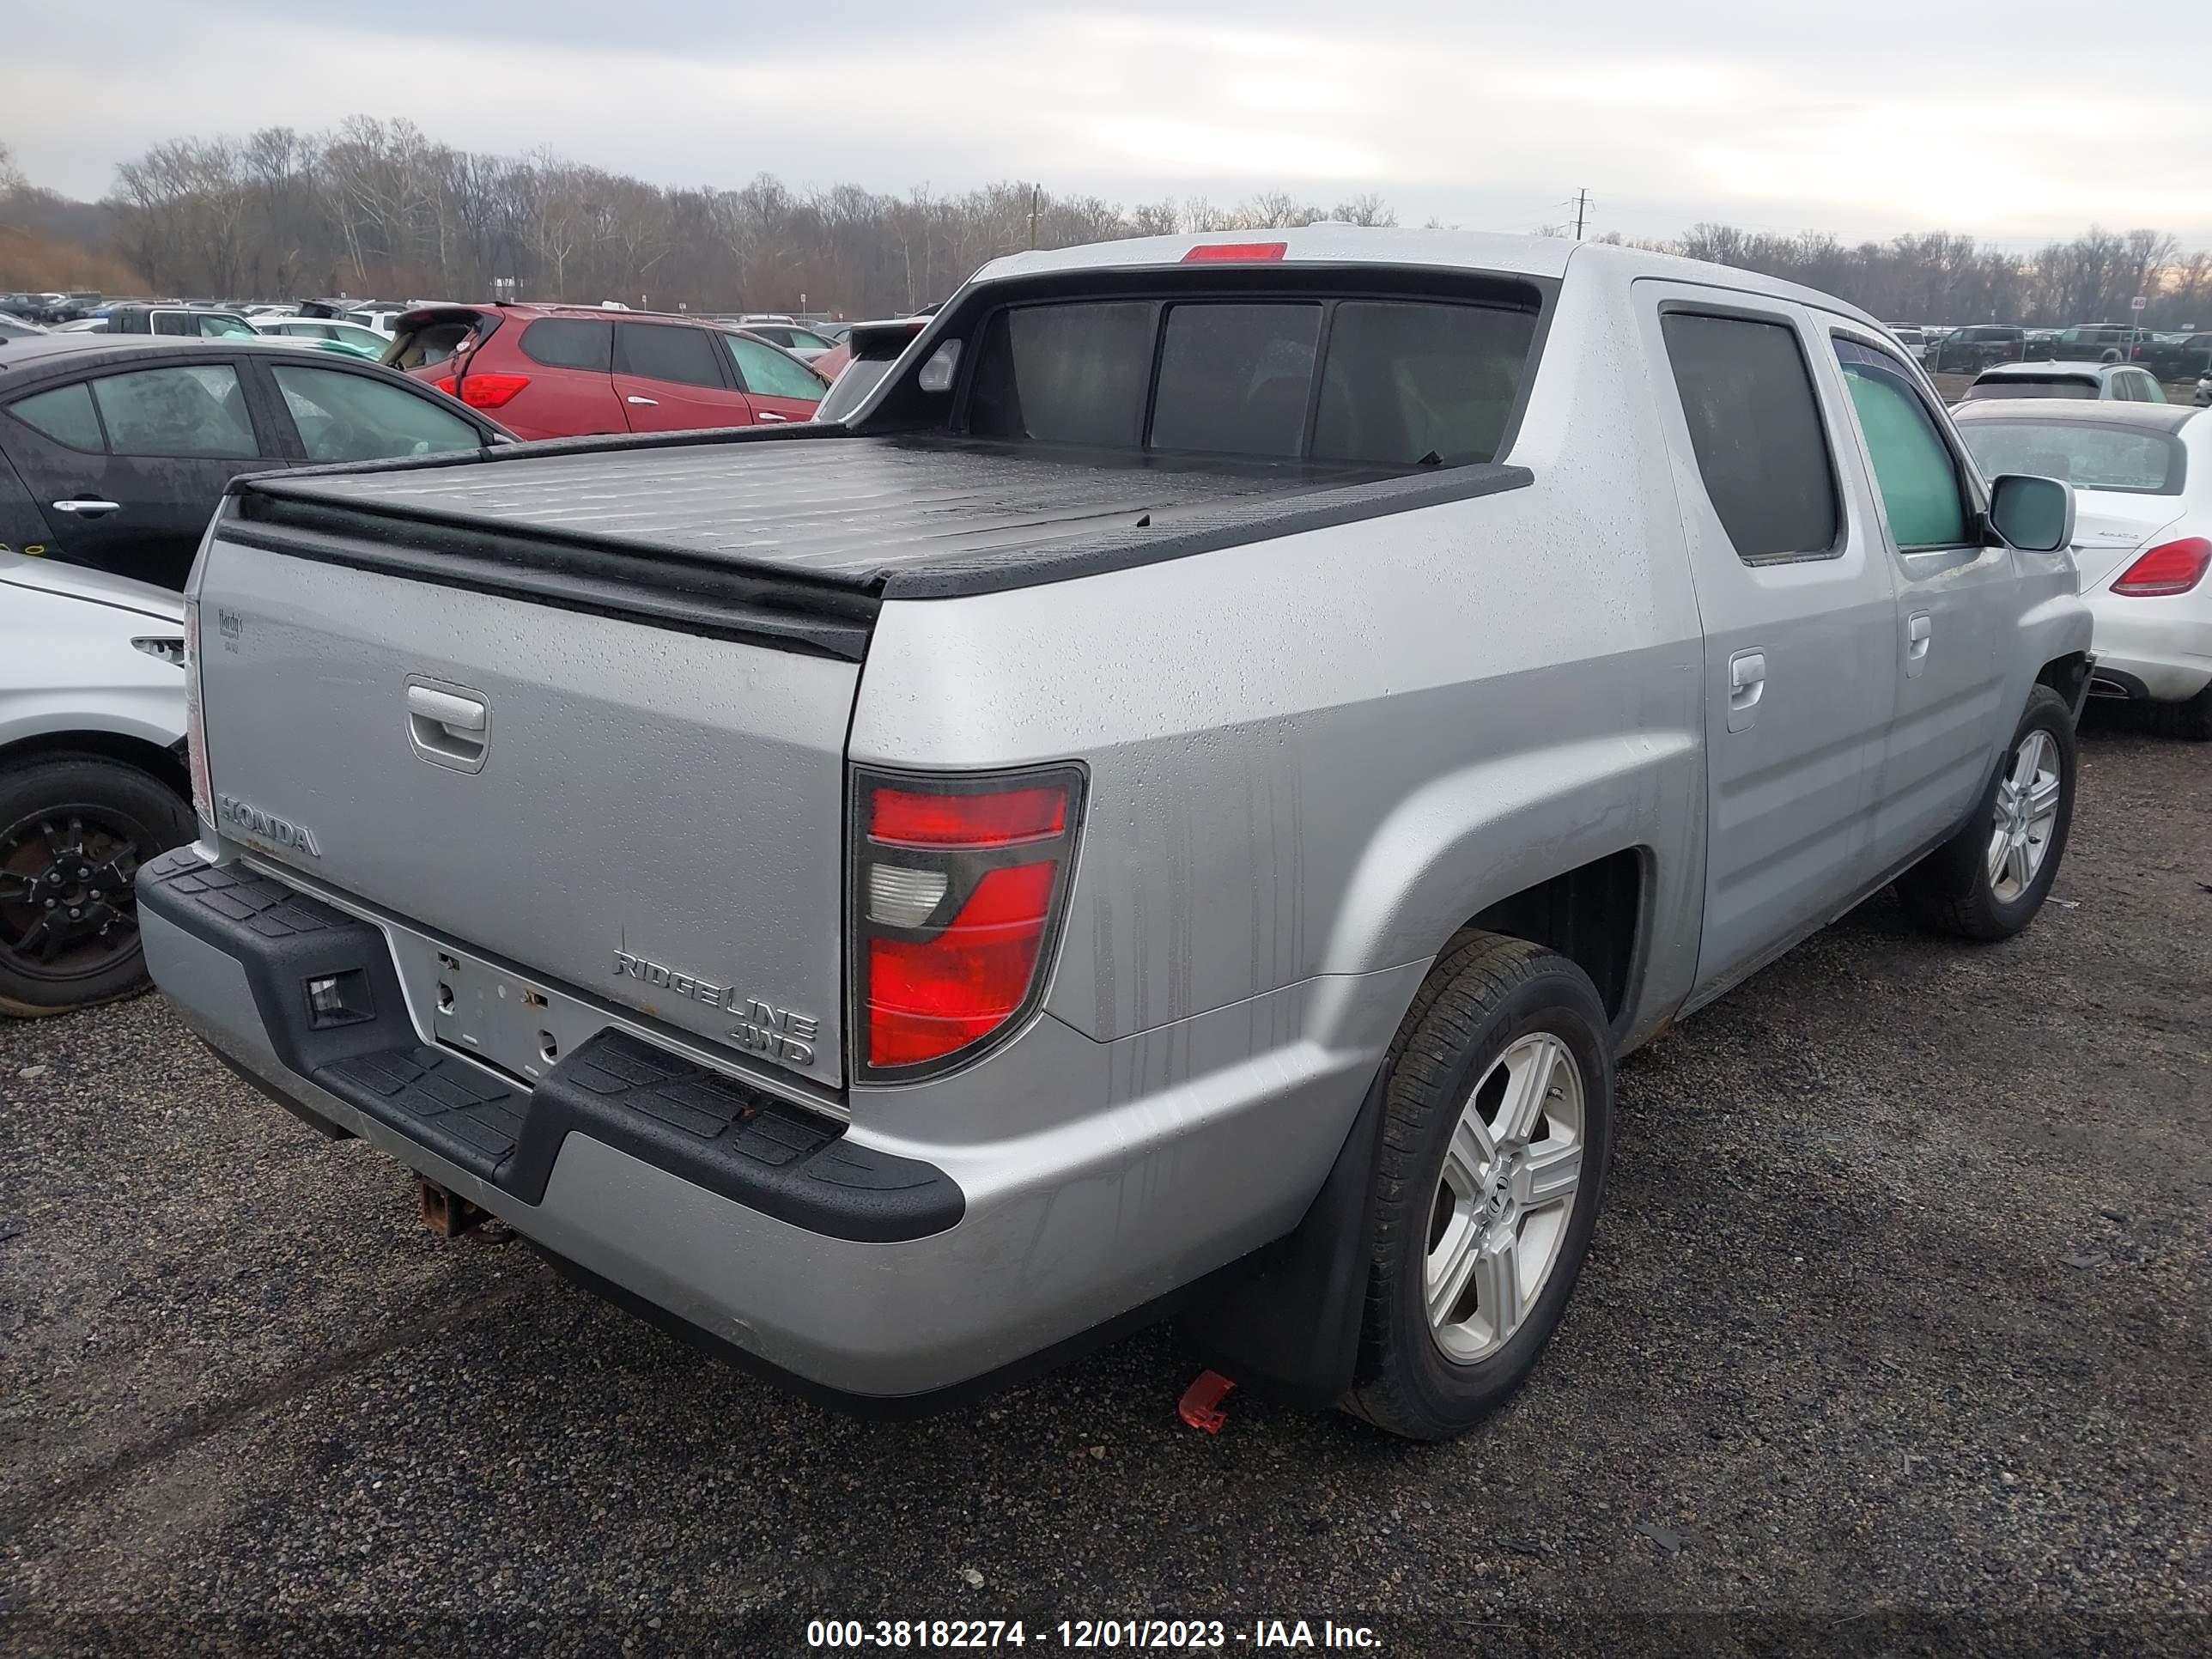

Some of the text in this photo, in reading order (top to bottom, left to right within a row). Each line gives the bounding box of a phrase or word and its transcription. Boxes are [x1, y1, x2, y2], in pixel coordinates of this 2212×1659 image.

[219, 608, 244, 640] Hardy's
[218, 793, 321, 858] HONDA
[613, 948, 818, 1042] RIDGELINE
[730, 1023, 815, 1066] 4WD
